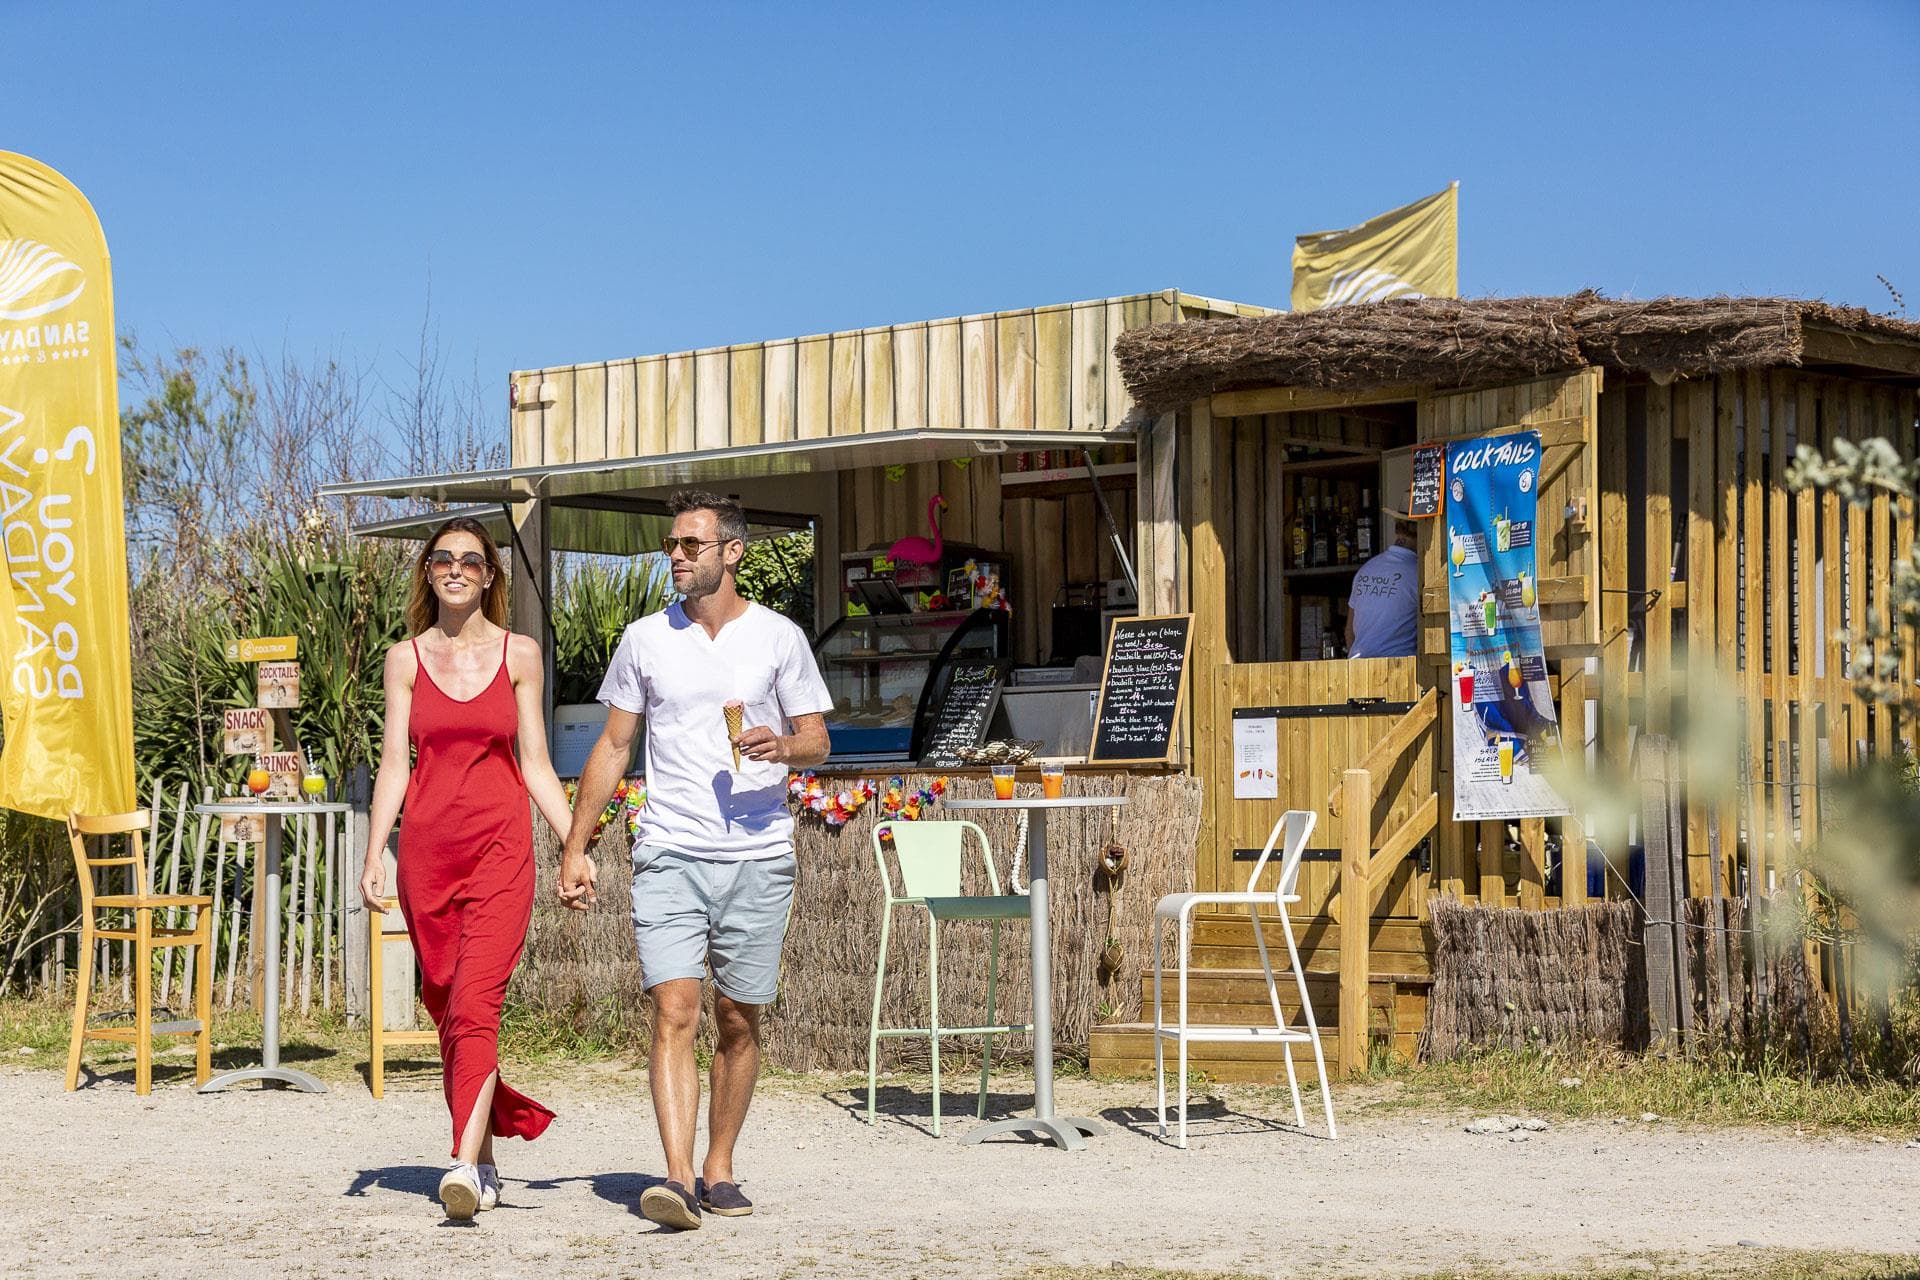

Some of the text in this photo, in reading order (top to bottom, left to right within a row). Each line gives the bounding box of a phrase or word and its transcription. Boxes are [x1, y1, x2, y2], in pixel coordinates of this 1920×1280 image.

[1453, 441, 1535, 474] COCKTAILS
[1371, 576, 1389, 585] YOU
[1356, 584, 1398, 598] STAFF
[259, 667, 299, 678] COCKTAILS
[226, 711, 265, 729] SNACK
